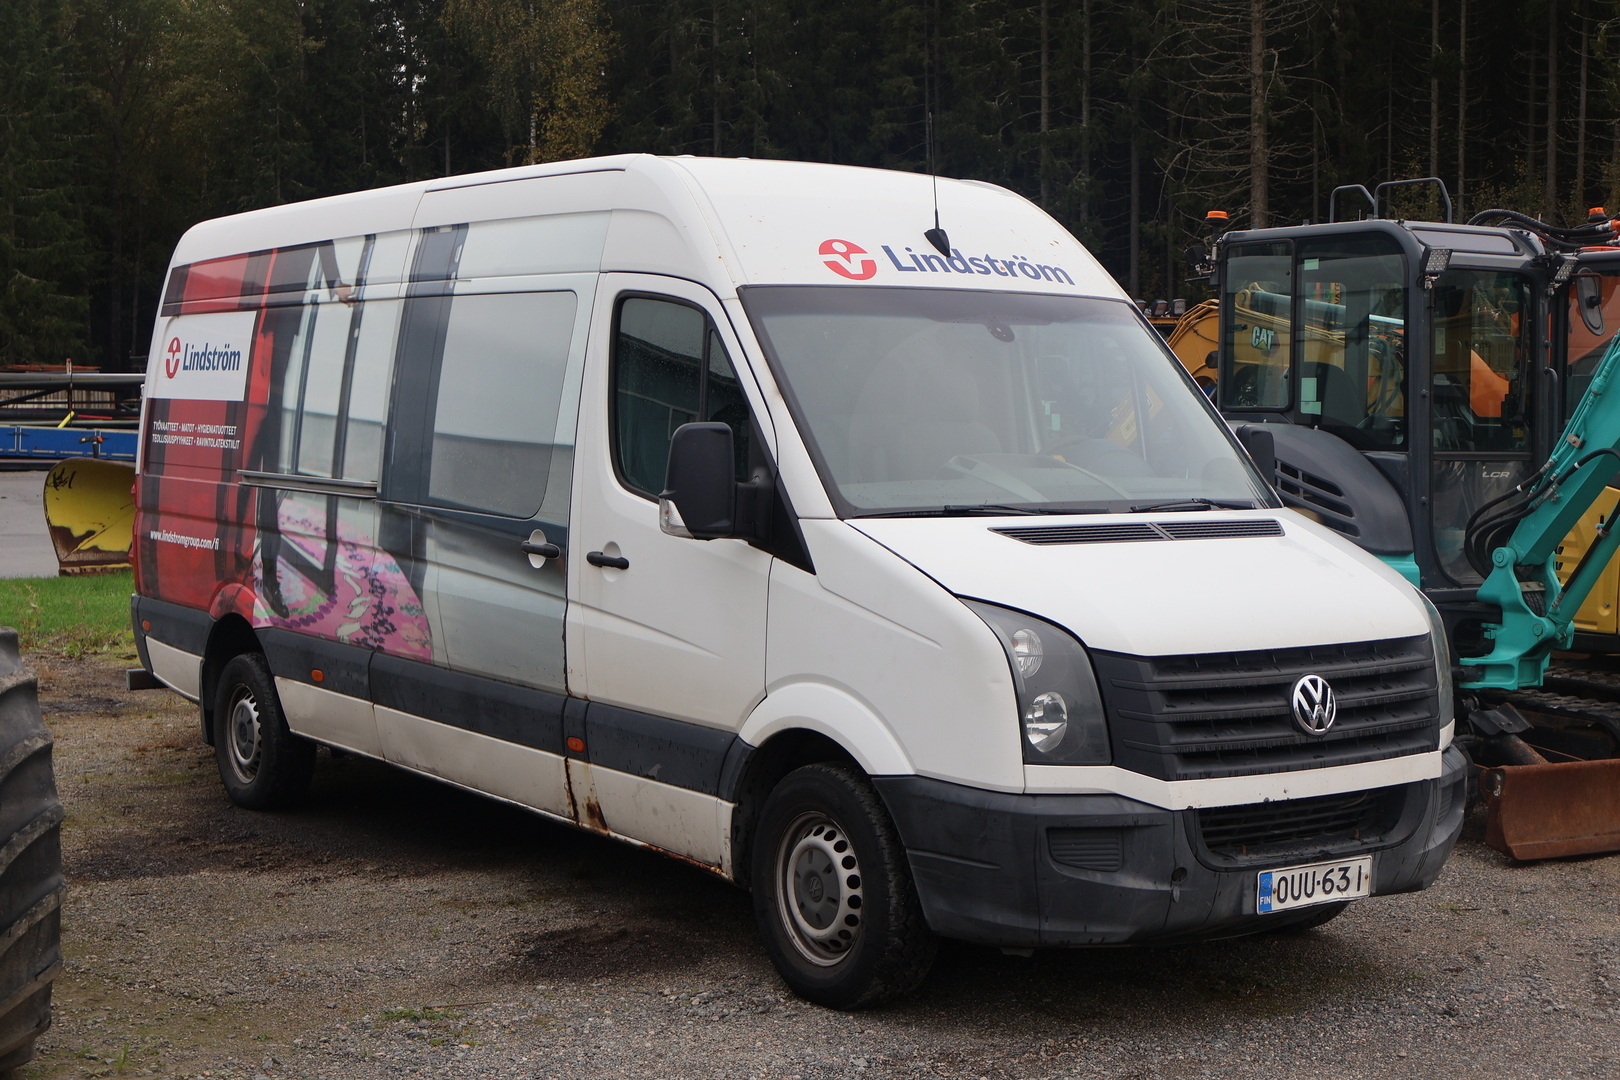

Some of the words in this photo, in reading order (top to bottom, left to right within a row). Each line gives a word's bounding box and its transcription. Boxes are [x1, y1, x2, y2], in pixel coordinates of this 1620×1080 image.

[881, 245, 1075, 285] Lindström
[1252, 326, 1275, 350] CAT
[182, 342, 241, 371] Lindström
[150, 529, 219, 550] www.lindstromgroup.com/fi
[1277, 864, 1362, 903] OUU-631
[1259, 895, 1271, 906] FIN
